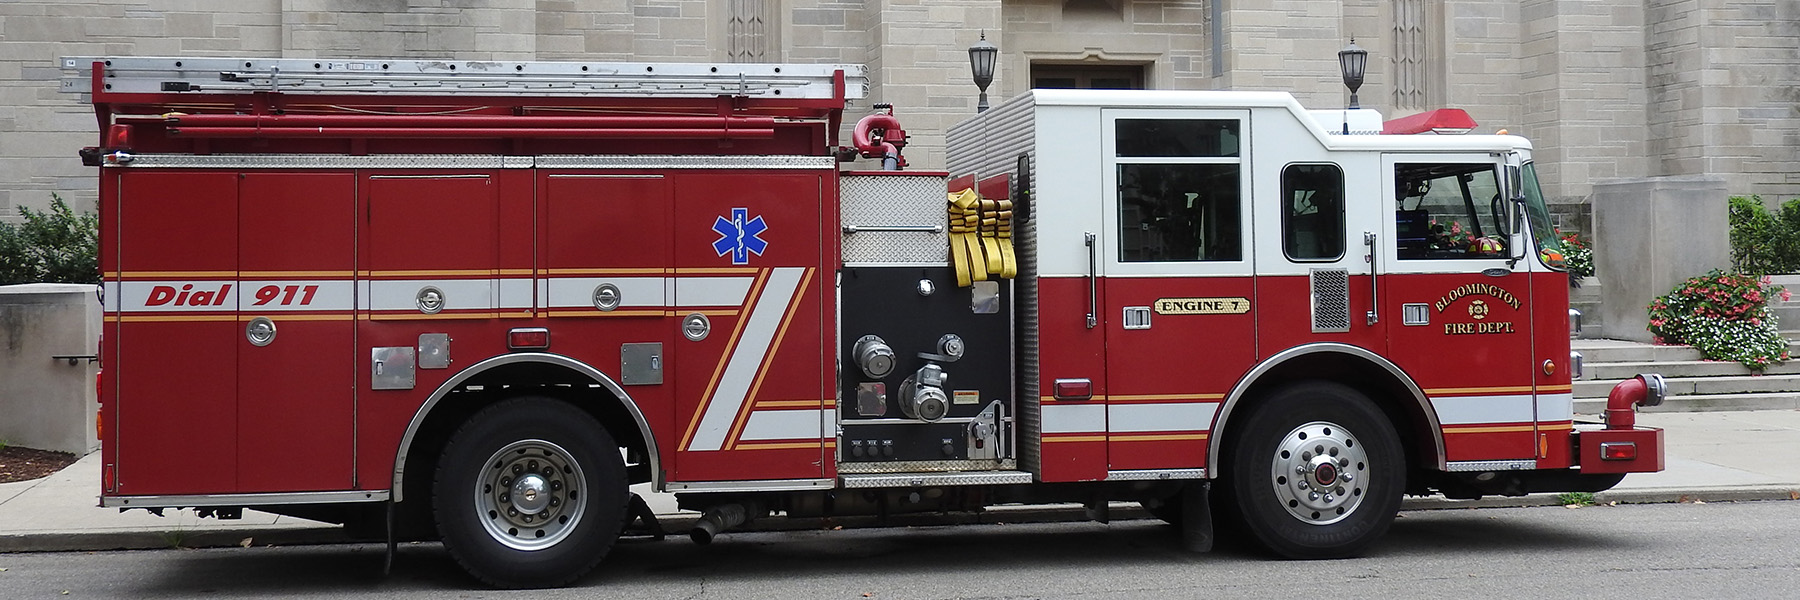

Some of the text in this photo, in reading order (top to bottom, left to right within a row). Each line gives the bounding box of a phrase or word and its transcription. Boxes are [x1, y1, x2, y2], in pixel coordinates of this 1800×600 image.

[144, 284, 319, 306] Dial 911
[1435, 283, 1522, 313] BLOOMINGTON
[1162, 301, 1239, 311] ENGINE 7
[1444, 322, 1515, 335] FIRE DEPT.
